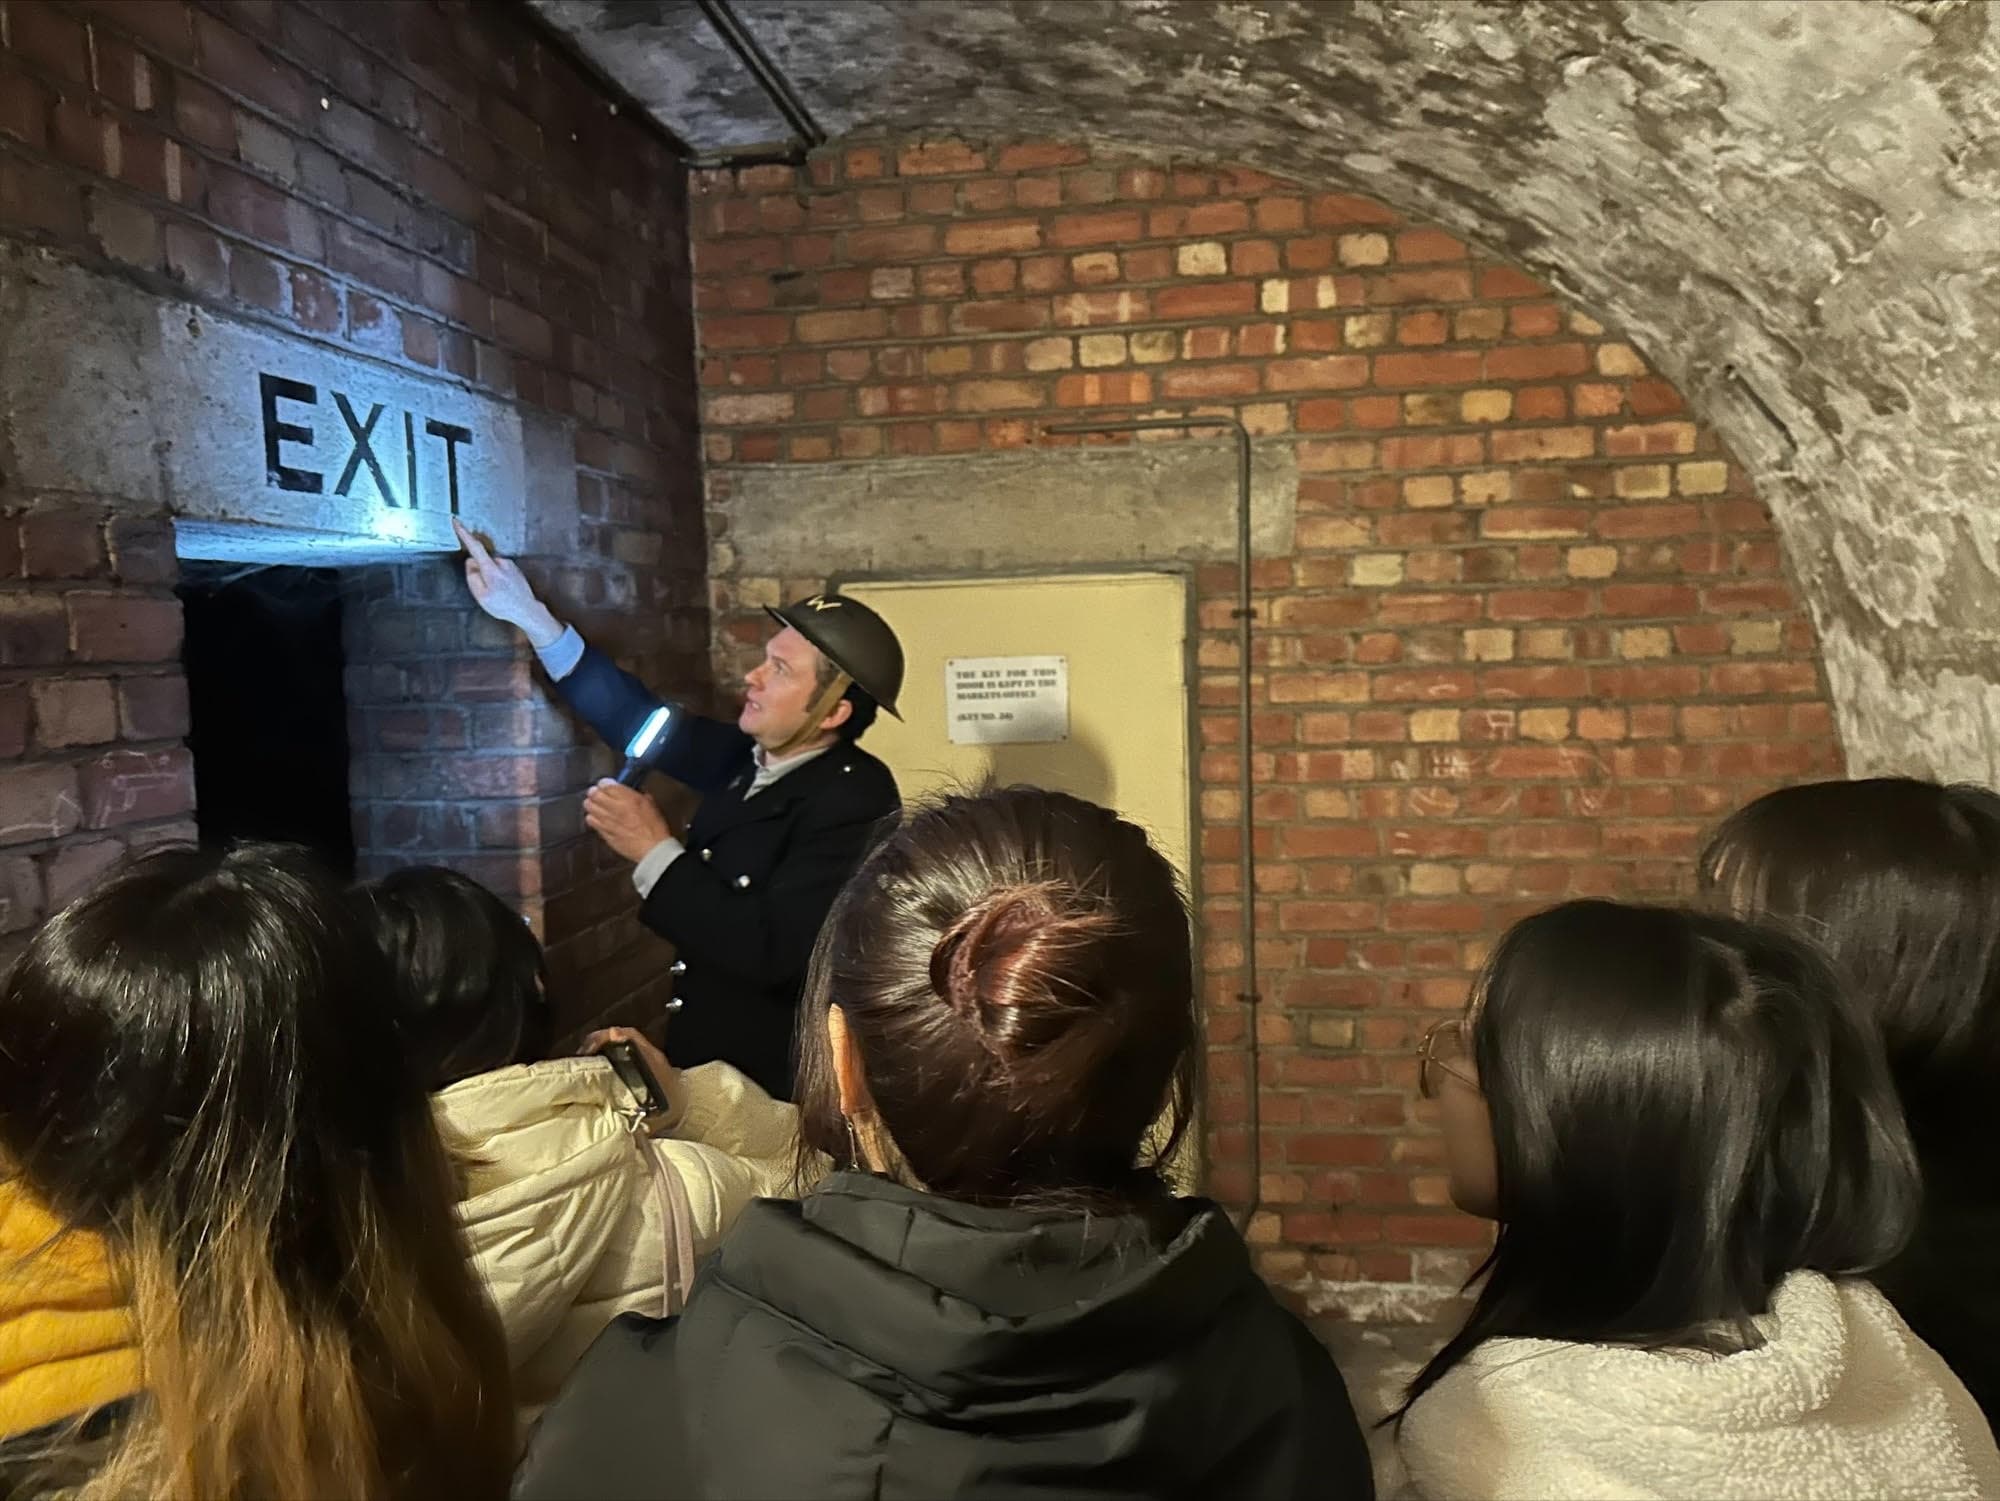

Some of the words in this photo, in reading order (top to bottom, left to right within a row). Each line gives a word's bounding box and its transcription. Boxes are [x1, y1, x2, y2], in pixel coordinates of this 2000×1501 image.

[259, 372, 473, 515] EXIT
[957, 671, 976, 679] THE
[982, 670, 1000, 678] KEY
[1007, 669, 1027, 677] FOR
[1033, 668, 1057, 676] THIS
[957, 682, 984, 690] DOOR
[987, 681, 996, 689] IS
[998, 680, 1022, 688] KEPT
[1025, 680, 1035, 688] IN
[1038, 679, 1057, 687] THE
